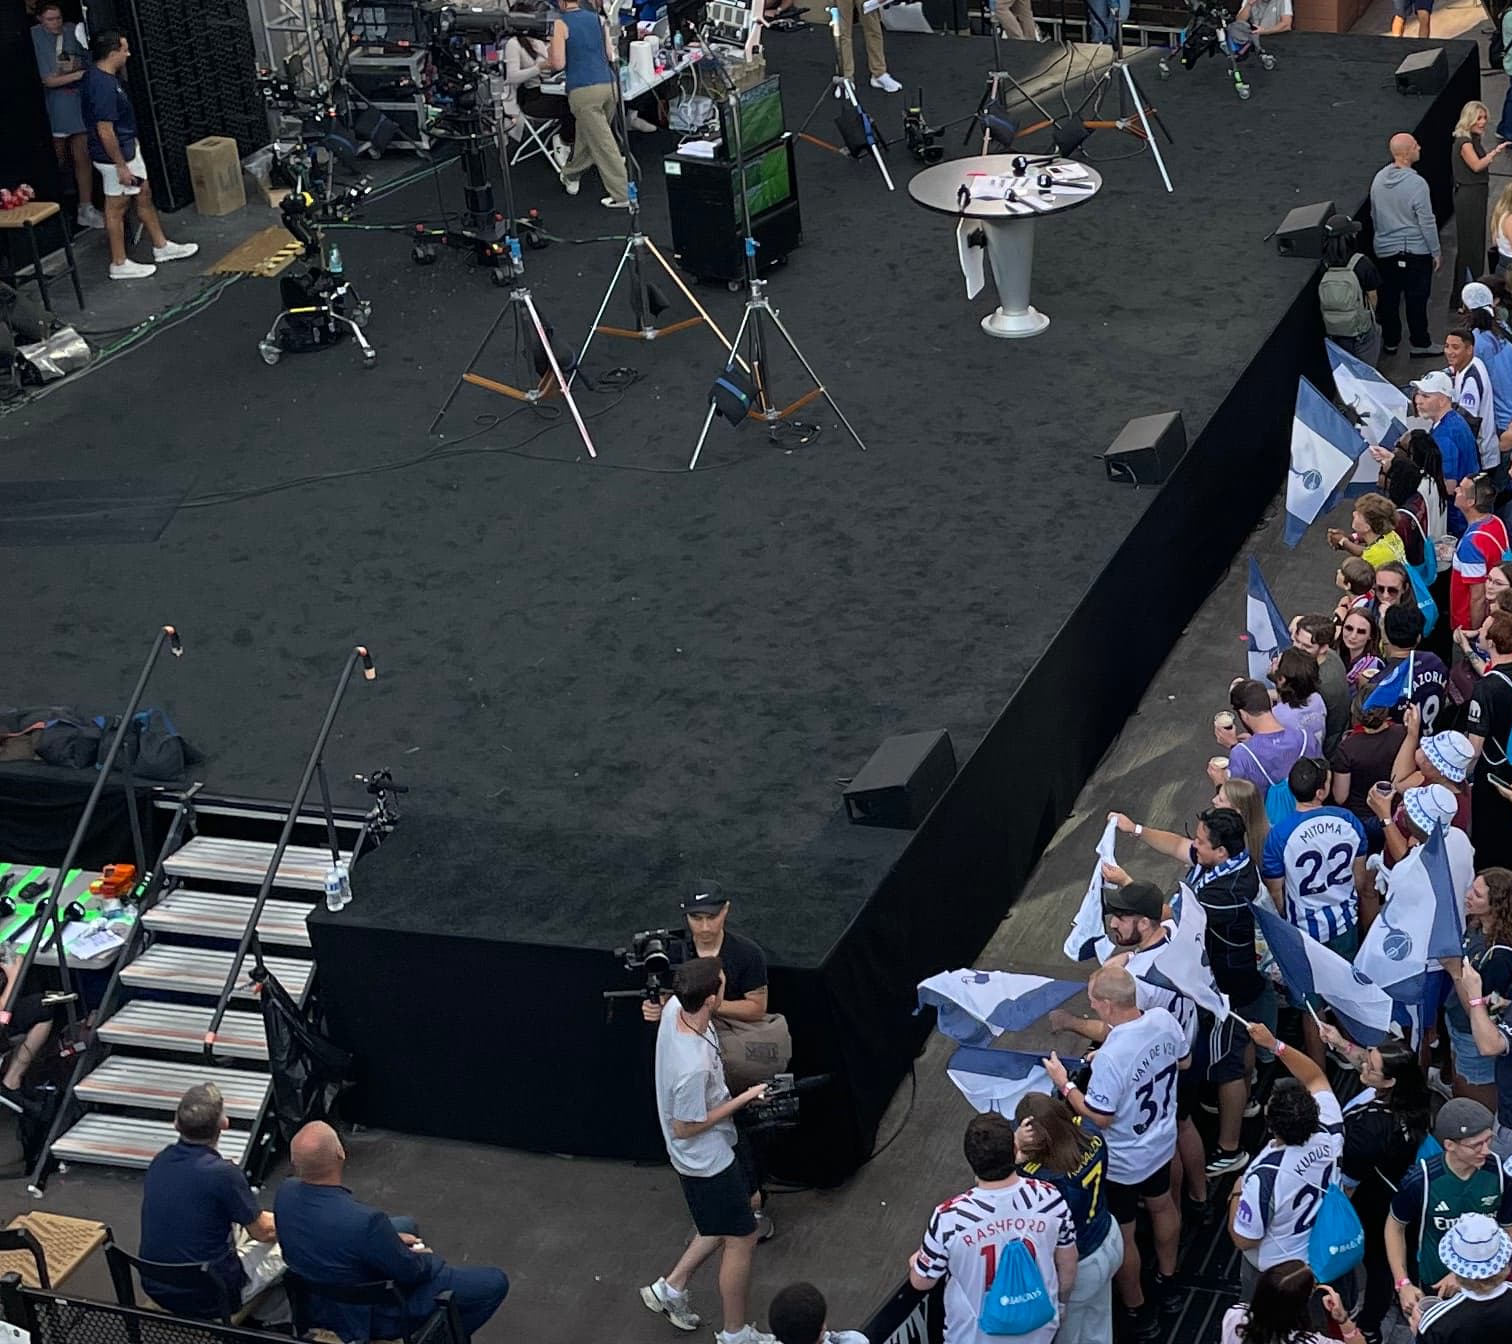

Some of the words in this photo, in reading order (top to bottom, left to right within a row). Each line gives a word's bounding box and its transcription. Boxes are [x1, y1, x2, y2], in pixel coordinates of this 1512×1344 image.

[1300, 822, 1343, 845] MITOMA
[1296, 842, 1354, 897] 22
[1132, 1059, 1150, 1084] VAN
[1150, 1047, 1162, 1065] DE
[1132, 1061, 1178, 1135] 37
[1293, 1143, 1332, 1177] KUDUS
[1082, 1161, 1103, 1222] 7
[963, 1217, 1047, 1249] RASHFORD
